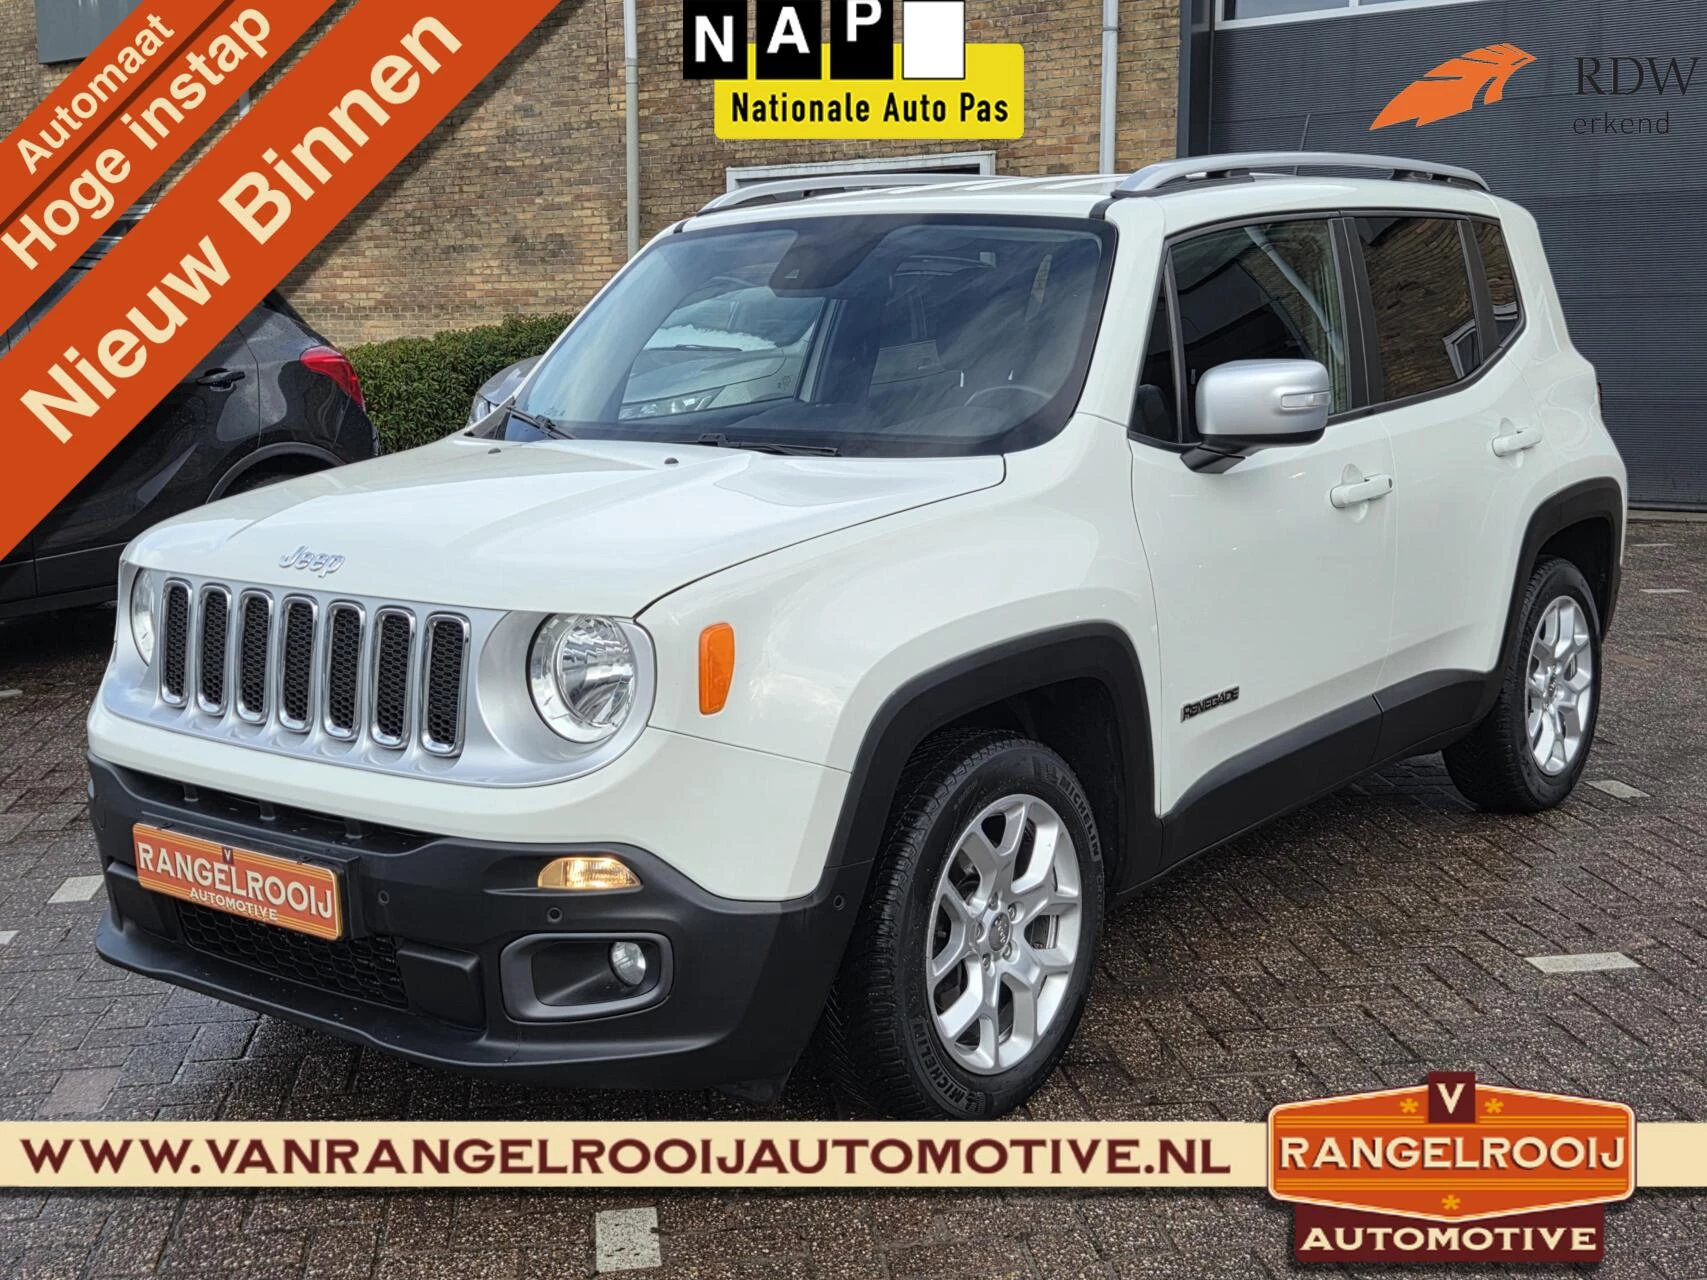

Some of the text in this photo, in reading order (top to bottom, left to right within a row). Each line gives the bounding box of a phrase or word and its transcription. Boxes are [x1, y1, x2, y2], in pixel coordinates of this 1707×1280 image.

[279, 545, 345, 578] Jeep
[1180, 686, 1240, 723] RENEGADE
[1057, 774, 1100, 858] MICHELIN
[224, 848, 231, 861] V
[137, 841, 333, 919] RANGELROOIJ
[189, 887, 278, 922] AUTOMOTIVE
[912, 1021, 966, 1104] MICHELIN
